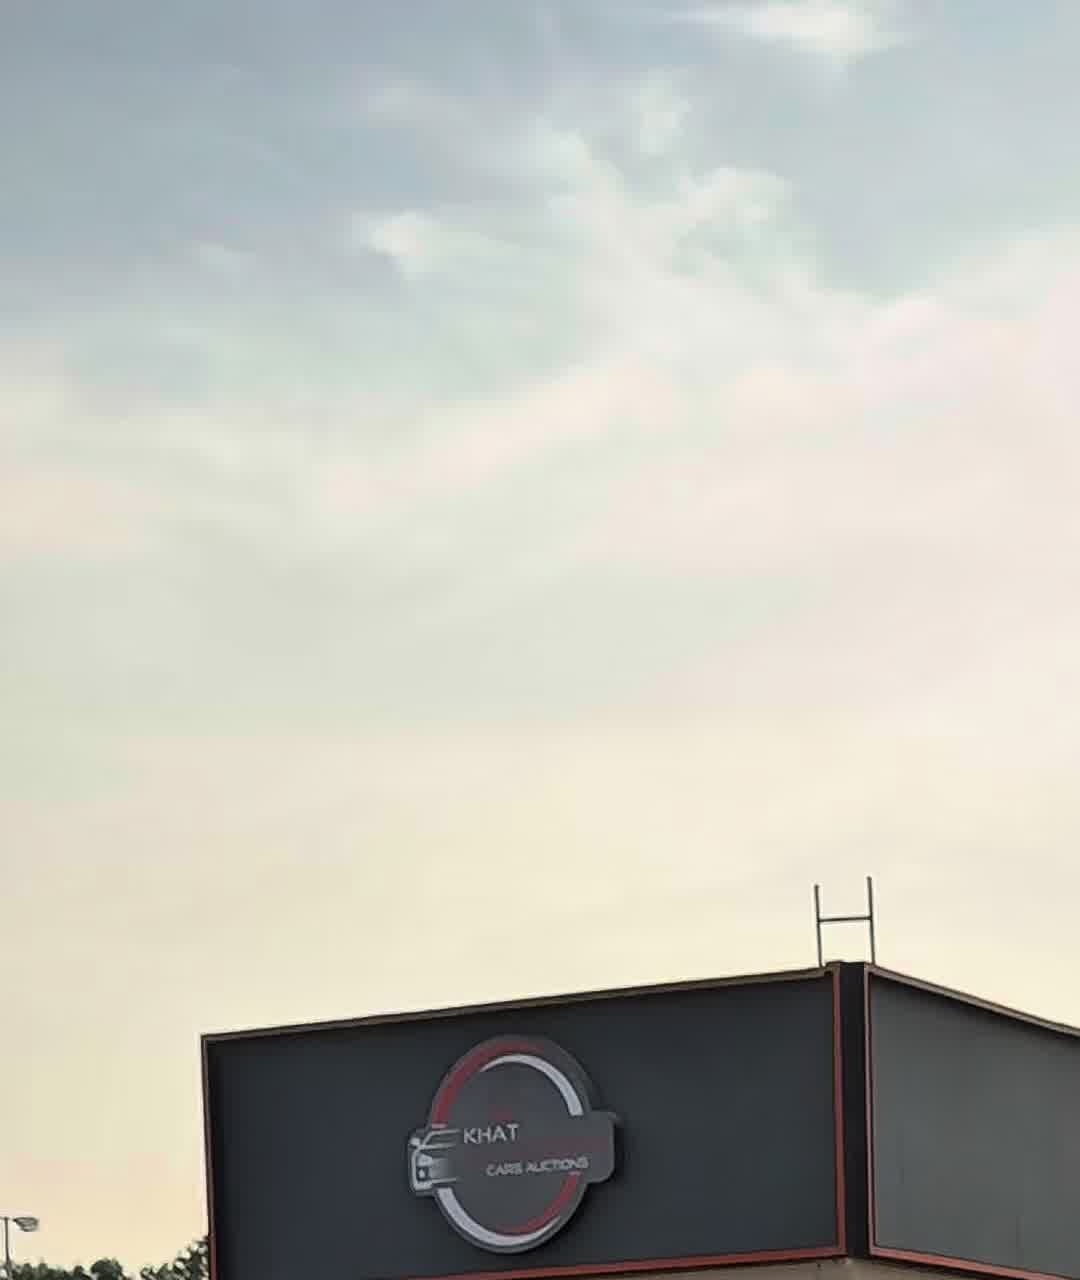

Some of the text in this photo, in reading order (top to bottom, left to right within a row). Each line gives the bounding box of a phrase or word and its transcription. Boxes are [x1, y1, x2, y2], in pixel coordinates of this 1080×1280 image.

[463, 1123, 519, 1144] KHAT
[486, 1156, 590, 1176] CARS AUCTIONS
